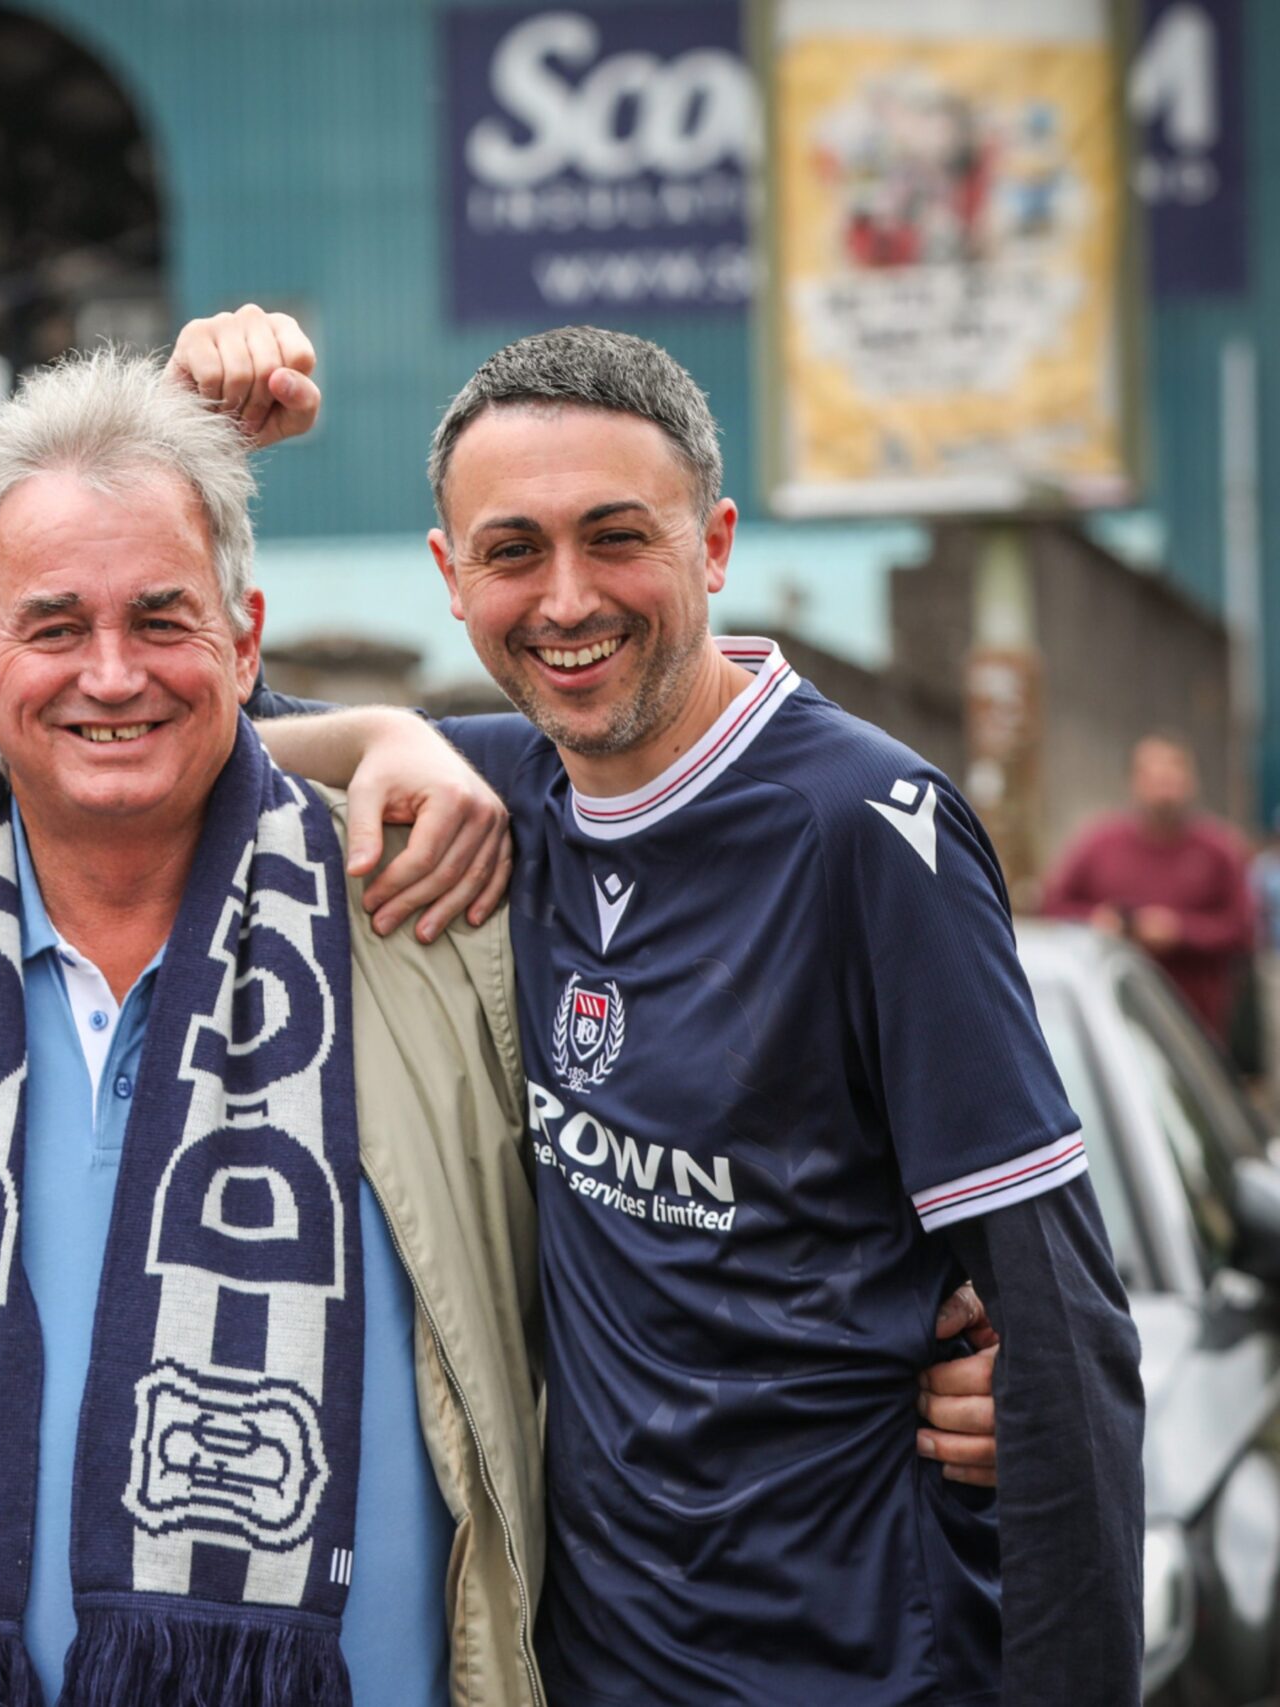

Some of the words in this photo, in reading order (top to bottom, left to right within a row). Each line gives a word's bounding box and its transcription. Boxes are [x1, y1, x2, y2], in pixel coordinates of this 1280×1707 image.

[567, 1067, 589, 1084] 1893
[524, 1077, 735, 1203] ROWN
[567, 1171, 647, 1219] services
[651, 1195, 737, 1231] limited
